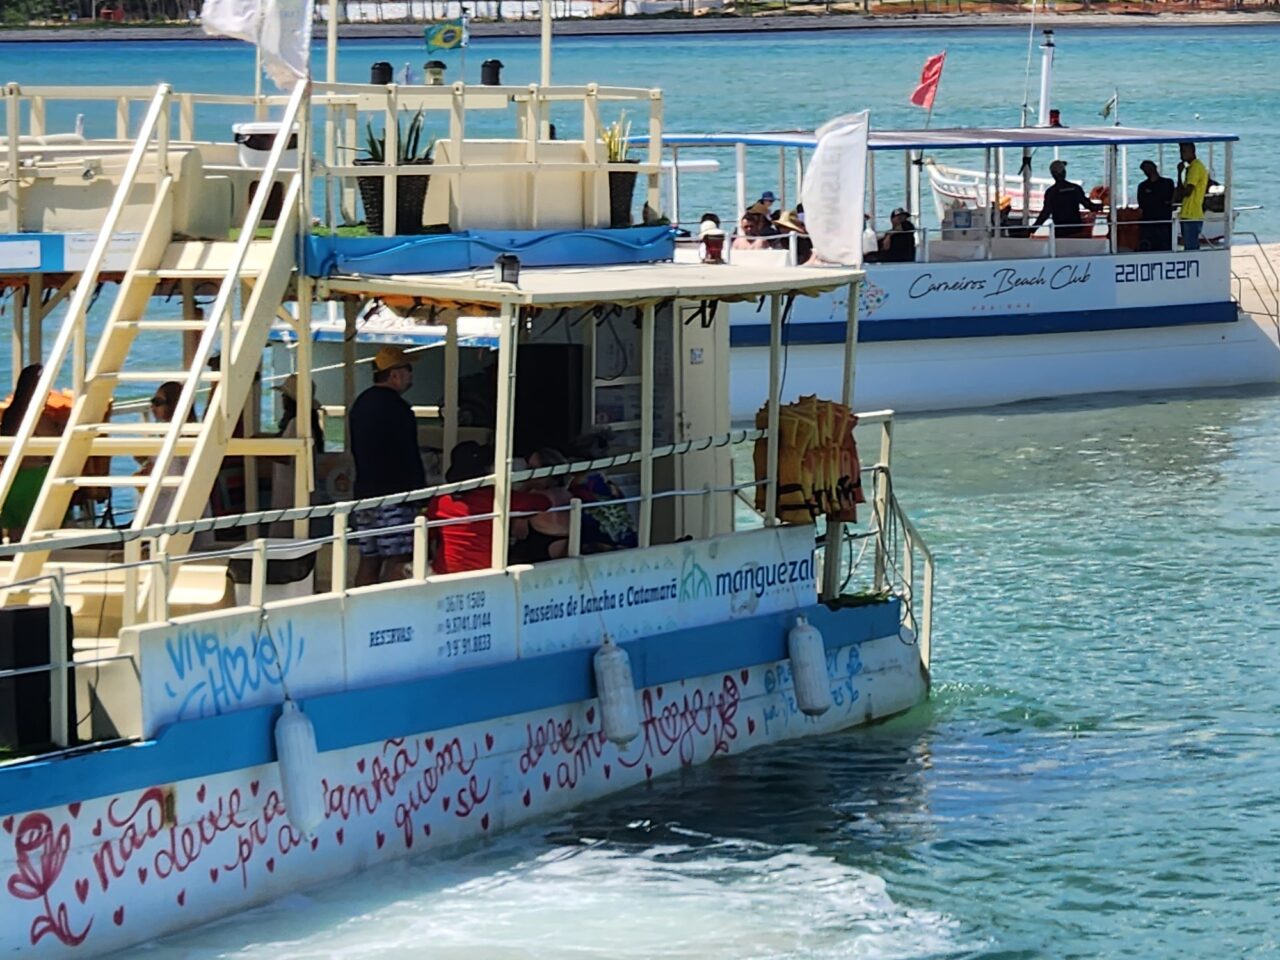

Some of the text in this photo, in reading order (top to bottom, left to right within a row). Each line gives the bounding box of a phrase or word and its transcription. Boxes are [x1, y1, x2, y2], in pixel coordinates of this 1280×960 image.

[908, 262, 1091, 299] Carneiros Beach Club
[523, 578, 677, 625] Passeios de Lancha e Catamarã
[716, 555, 815, 598] manguezal
[224, 735, 420, 890] pra aanhã
[395, 737, 491, 849] quem se
[154, 788, 247, 879] deixe
